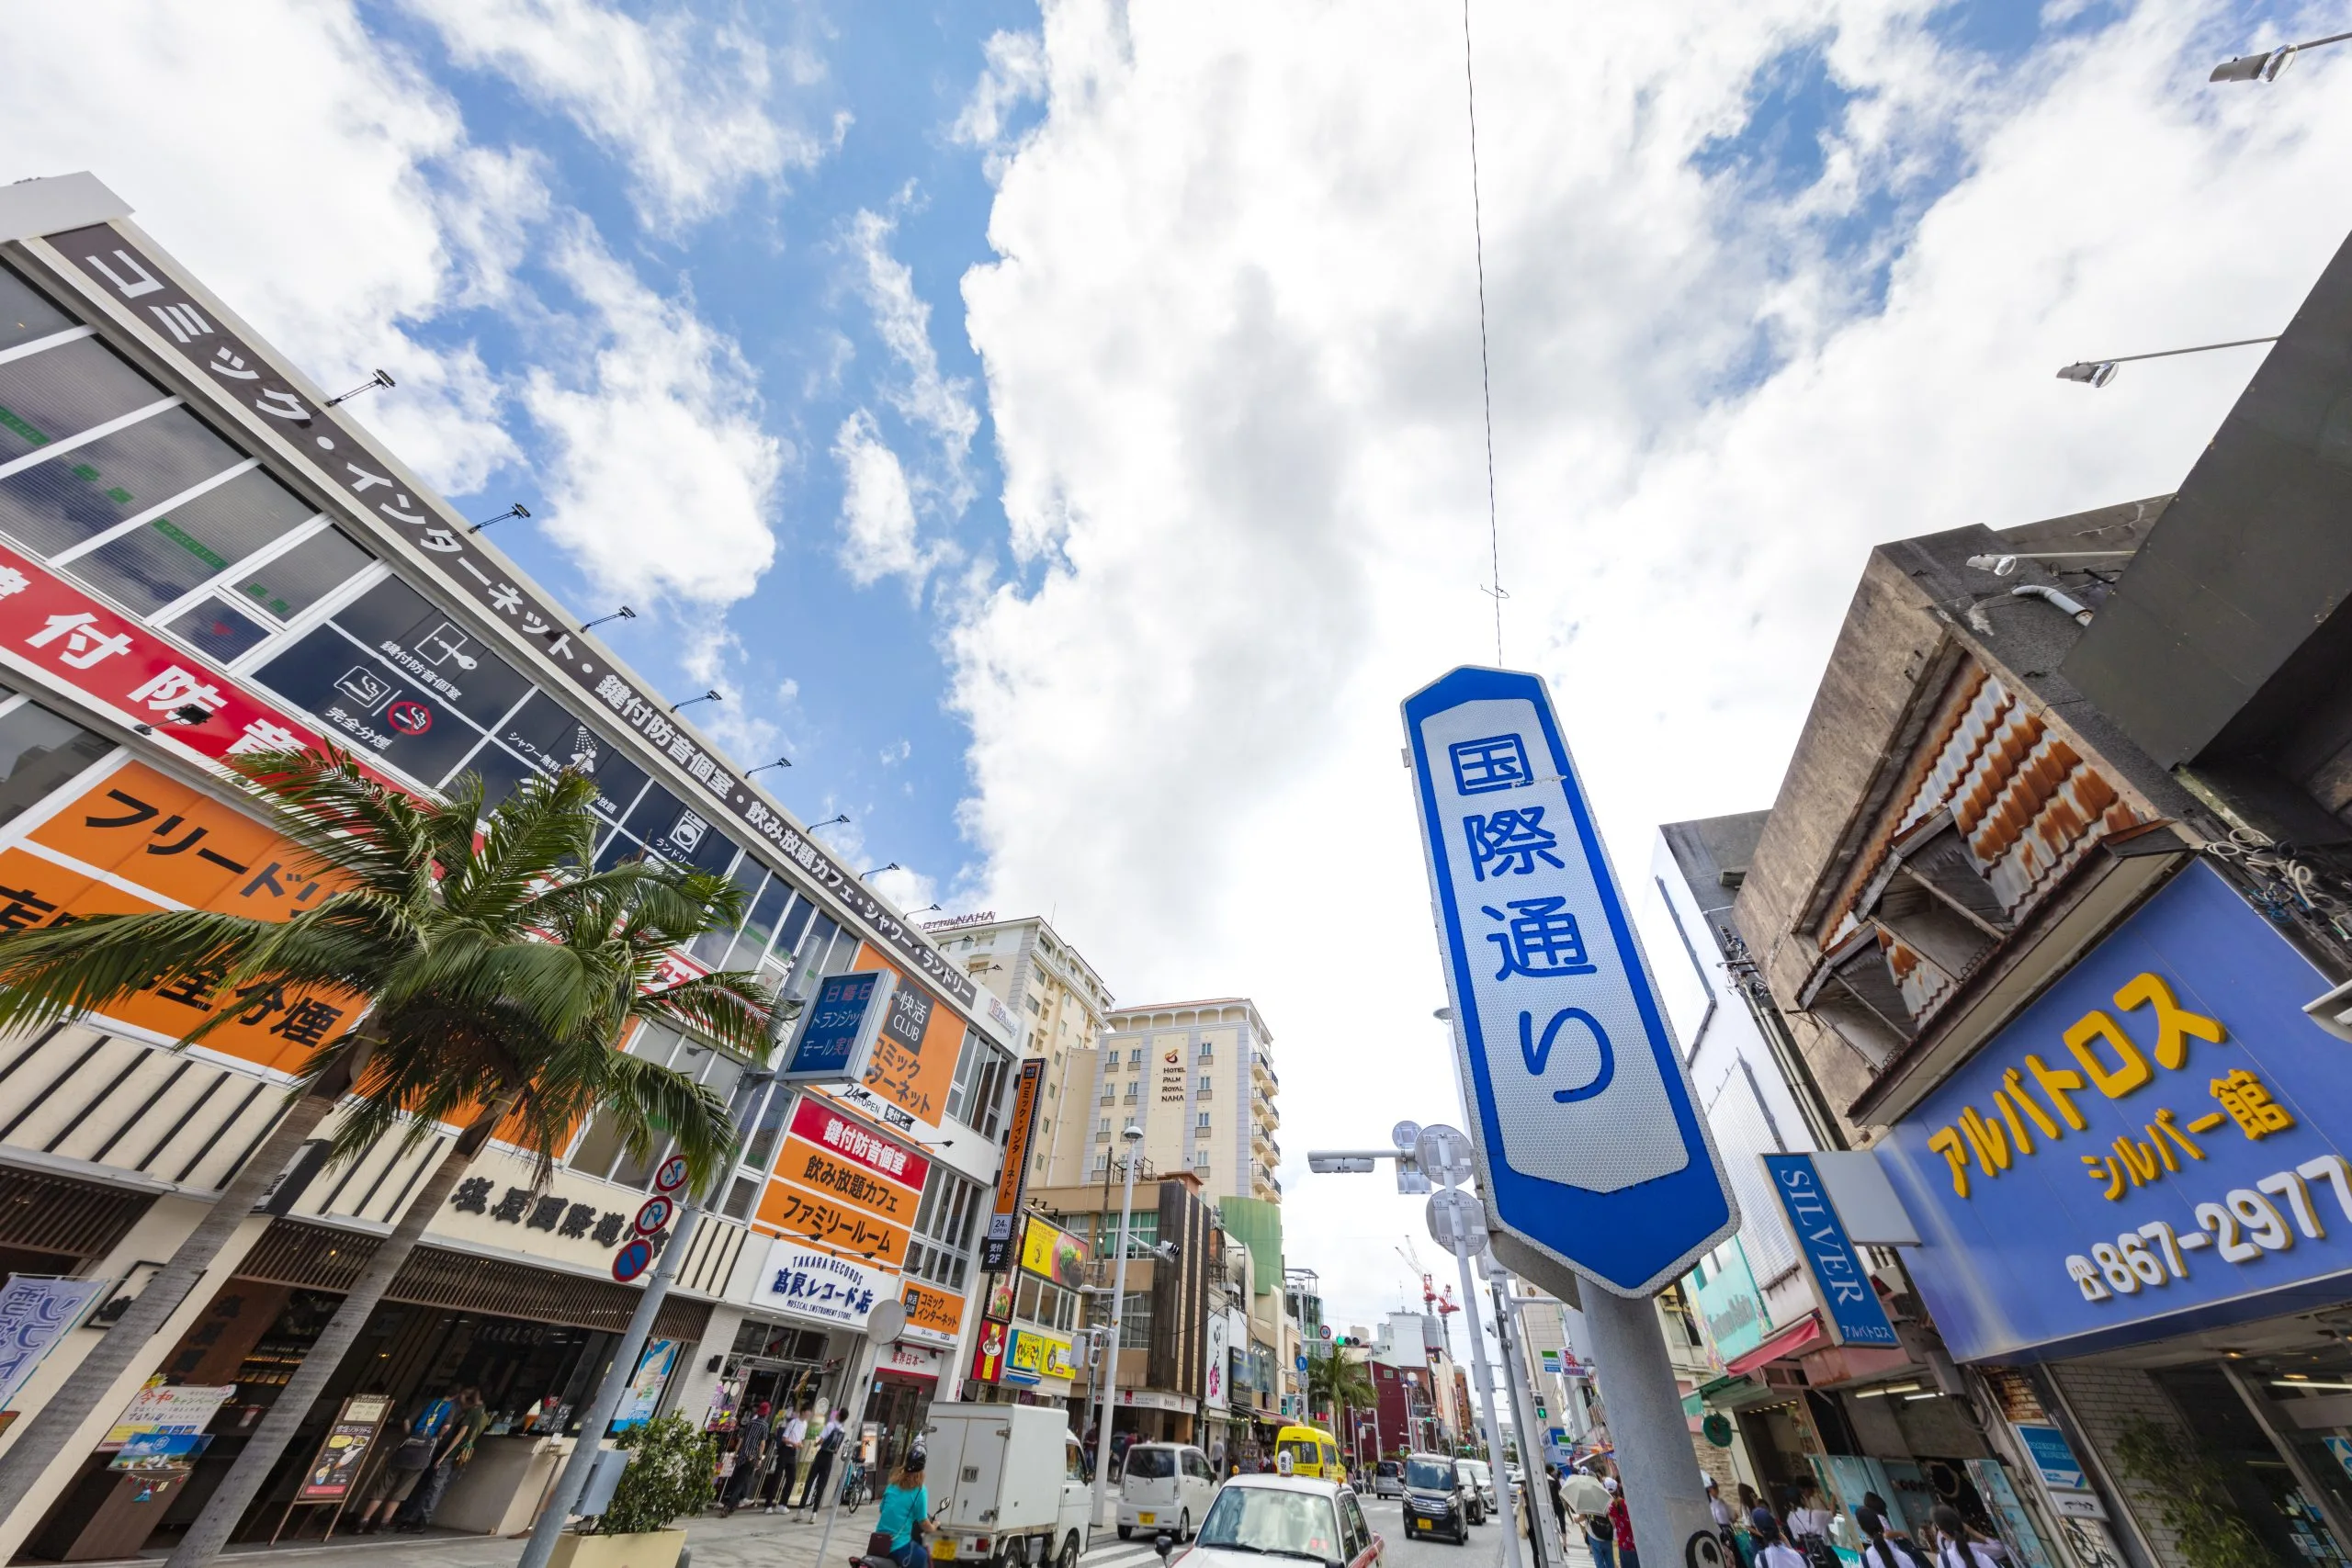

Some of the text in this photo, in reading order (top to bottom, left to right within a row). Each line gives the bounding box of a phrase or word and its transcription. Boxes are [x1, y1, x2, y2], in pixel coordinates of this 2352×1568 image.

[379, 640, 462, 702] 鍵付防音個室
[324, 706, 393, 750] 完全分煙
[655, 836, 695, 867] ランドリー
[1448, 732, 1615, 1104] 国際通り
[825, 983, 874, 1003] 日曜日
[899, 990, 927, 1025] 快活
[893, 1014, 920, 1042] CLUB
[874, 1037, 922, 1079] コミック
[1161, 1094, 1184, 1102] NAHA
[1928, 972, 2227, 1199] アルバトロス
[861, 1099, 881, 1114] OPEN
[822, 1117, 907, 1177] 鍵付防音個室
[1003, 1081, 1032, 1199] コミック・インターネット
[2080, 1068, 2297, 1201] シルバー館
[802, 1154, 899, 1213] 飲み放題カフェ
[783, 1194, 890, 1254] ファミリールーム
[1780, 1169, 1865, 1307] SILVER
[988, 1254, 1001, 1264] 2F
[989, 1243, 1003, 1252] 受付
[793, 1256, 864, 1285] TAKARA RECORDS
[786, 1299, 853, 1320] MUSICAL INSTRUMENT STORE
[918, 1307, 957, 1327] インターネット
[921, 1293, 945, 1309] コミック
[1841, 1325, 1893, 1339] アルバトロス
